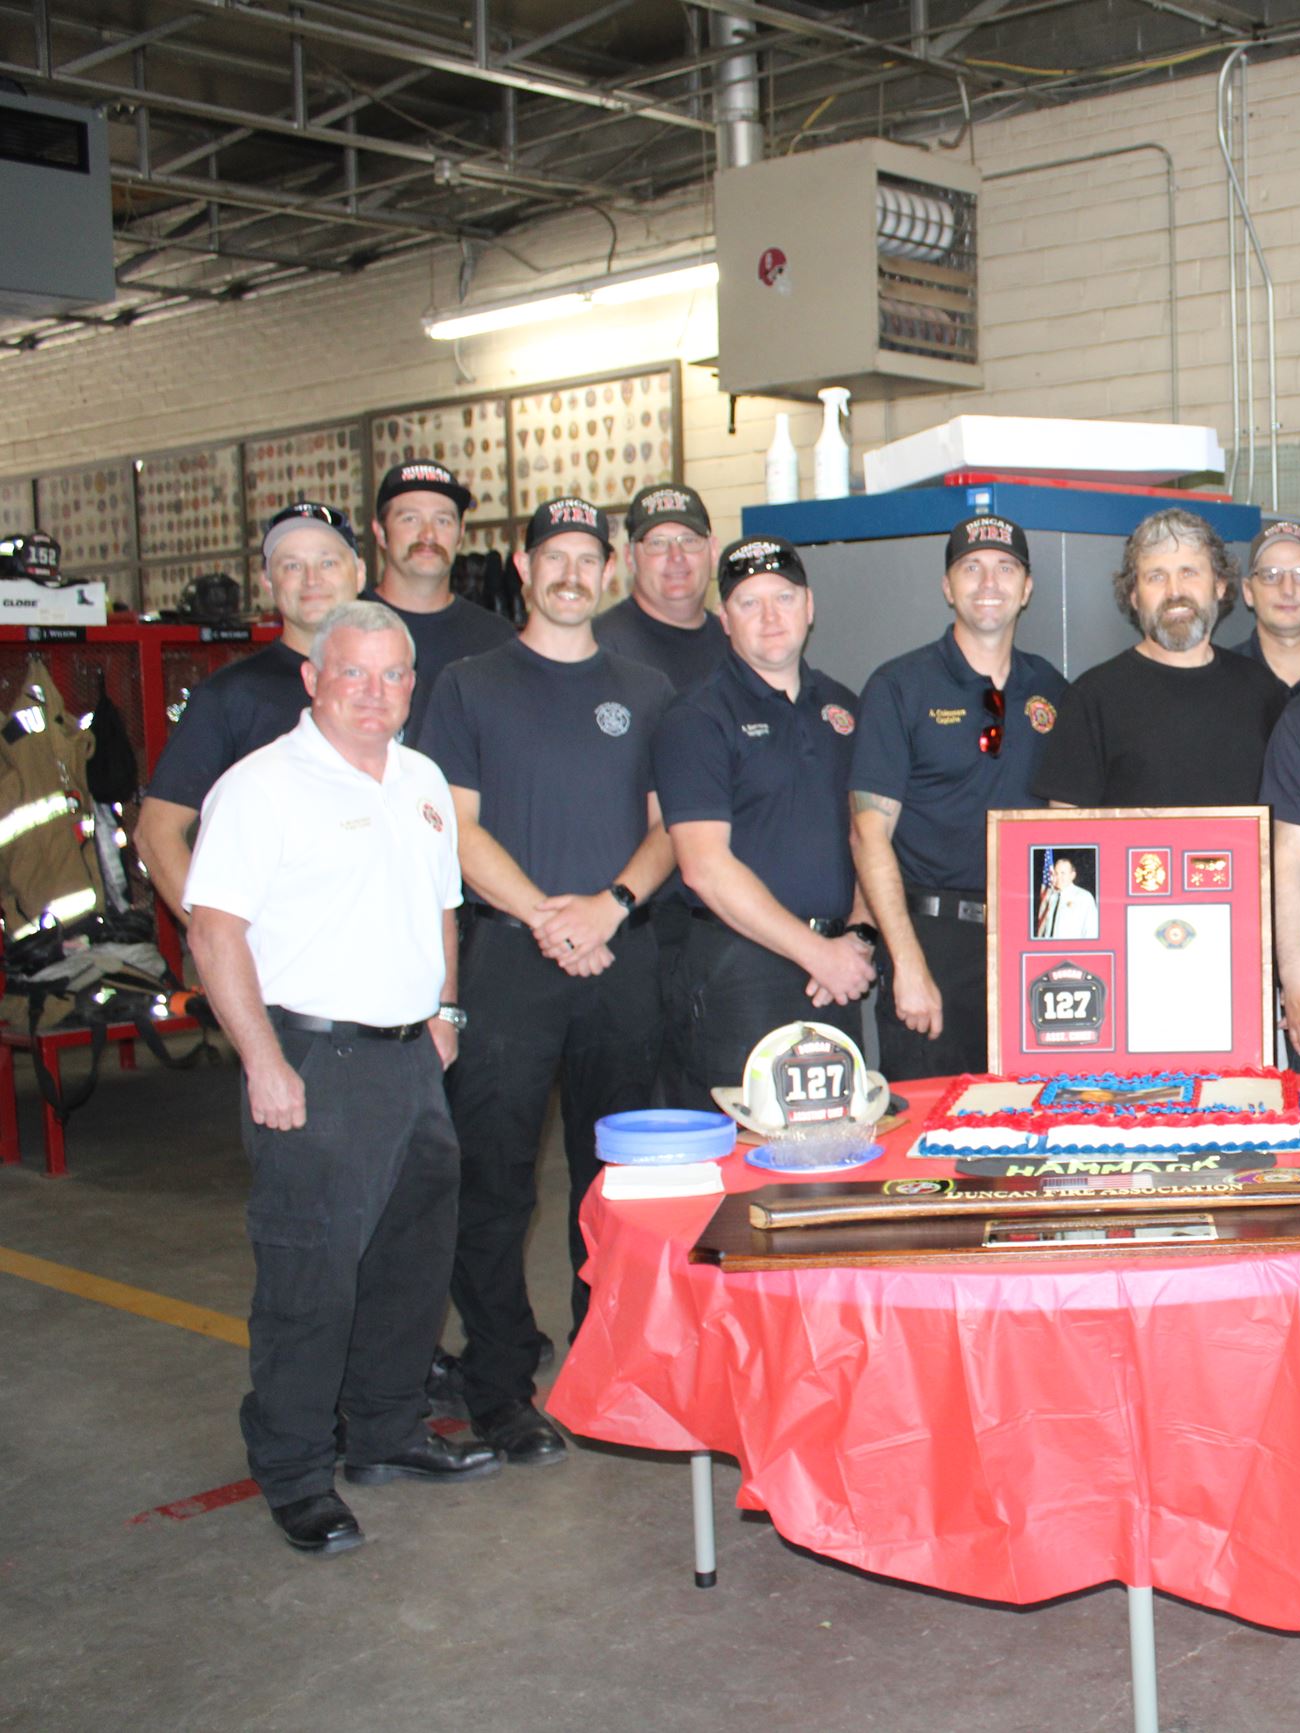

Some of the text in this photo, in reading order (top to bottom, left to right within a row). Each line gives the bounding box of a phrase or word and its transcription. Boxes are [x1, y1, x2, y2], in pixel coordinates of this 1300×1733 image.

[549, 499, 598, 516] DUNCAN
[550, 507, 598, 528] FIRE
[966, 517, 1014, 533] DUNCAN
[967, 525, 1013, 545] FIRE
[27, 545, 58, 567] 152
[3, 599, 39, 608] GLOBE
[1043, 990, 1092, 1020] 127
[787, 1063, 845, 1101] 127
[944, 1183, 1244, 1200] DUNCAN FIRE ASSOCIATION
